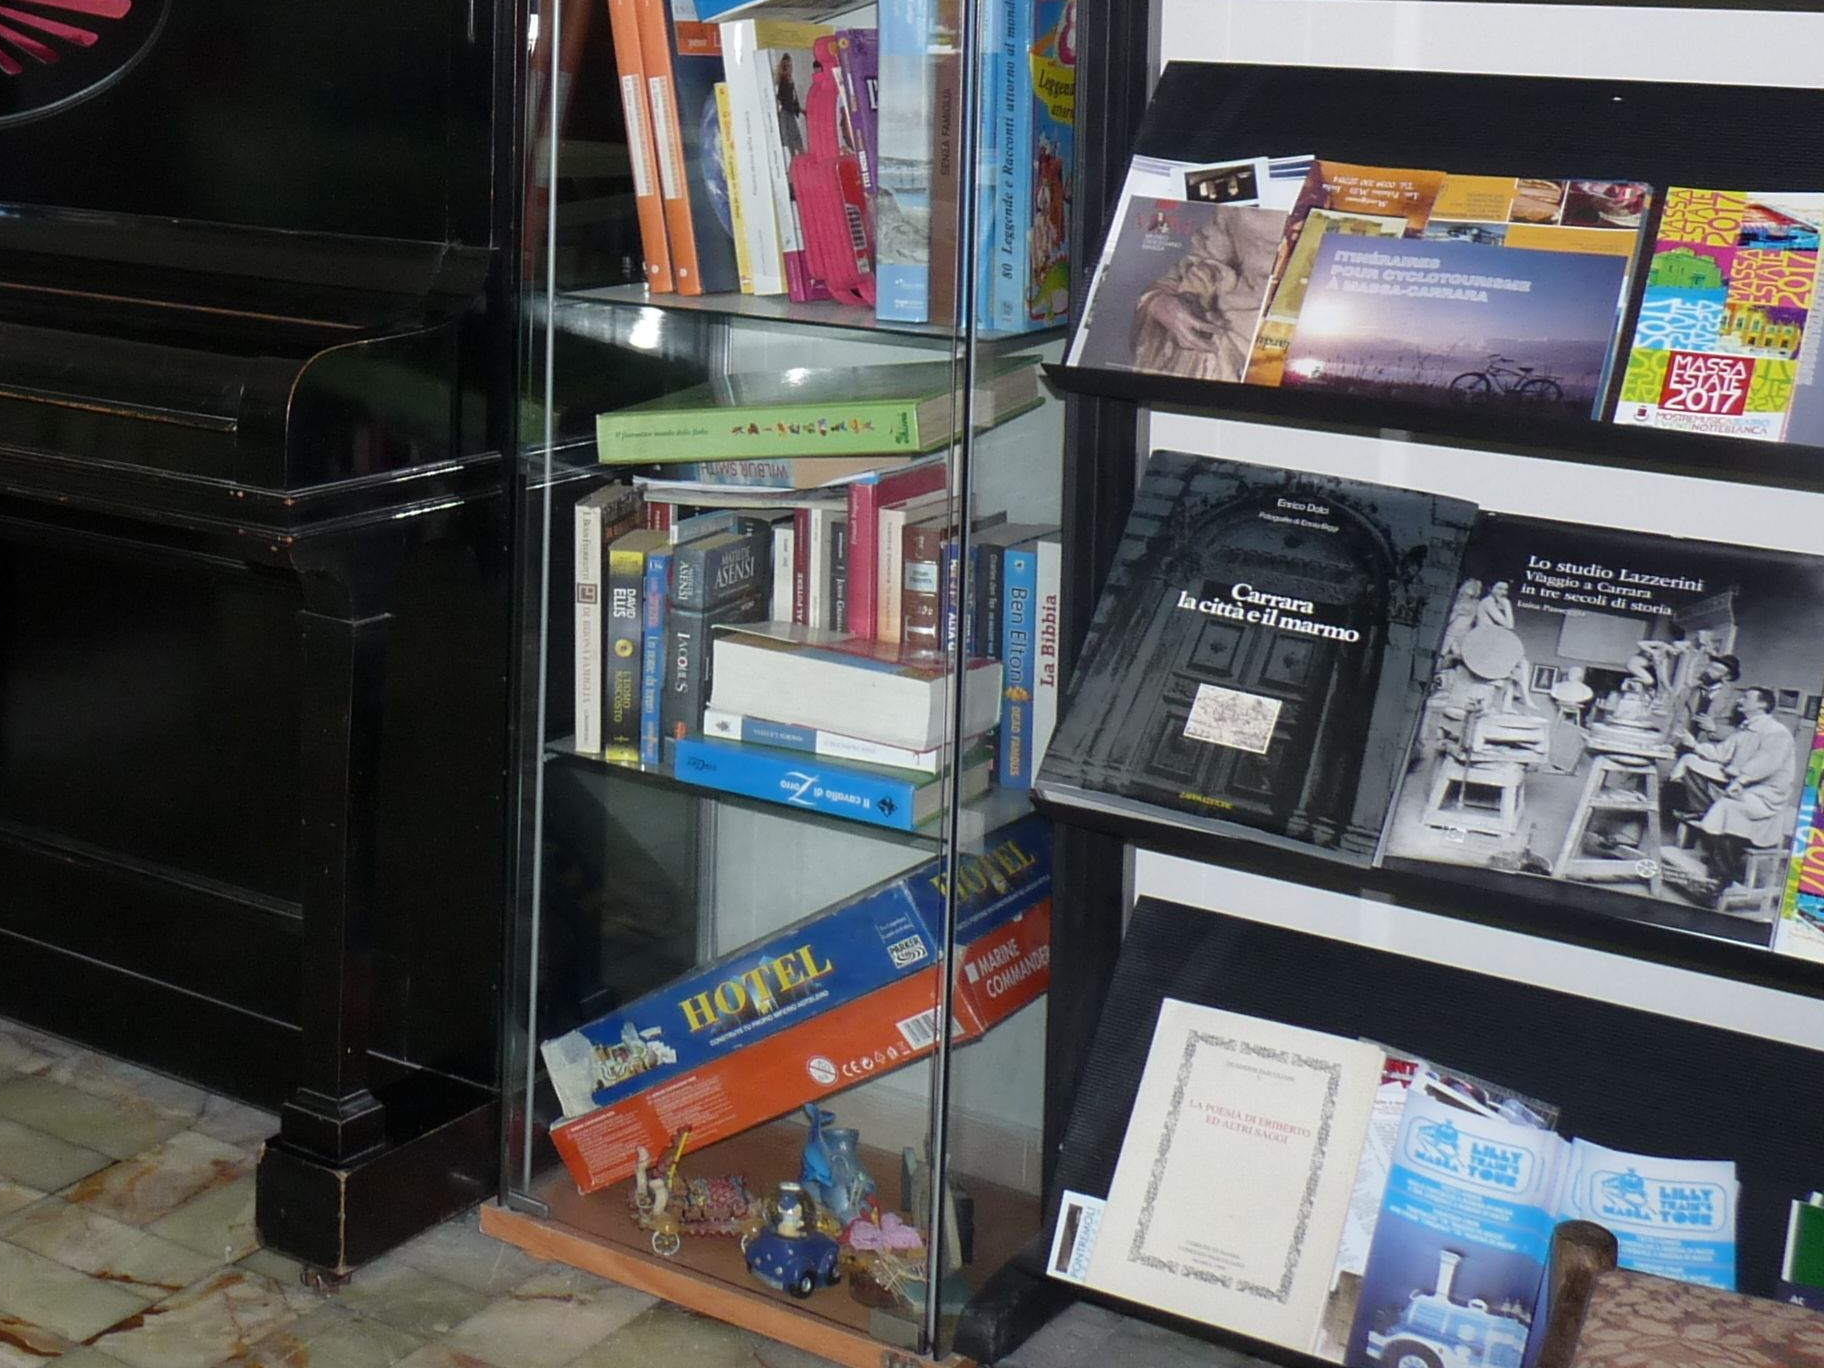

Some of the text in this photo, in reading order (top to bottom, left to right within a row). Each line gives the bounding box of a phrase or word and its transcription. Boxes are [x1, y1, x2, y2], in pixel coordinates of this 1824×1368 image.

[1005, 43, 1016, 57] al
[1006, 59, 1015, 113] attorno
[941, 88, 952, 177] SENZA FAMIGLIA
[1004, 118, 1015, 176] Racconti
[1003, 198, 1016, 257] Leggende
[1659, 189, 1693, 242] MASSA
[1679, 192, 1716, 244] ESTATE
[1704, 192, 1745, 246] 2017
[1005, 260, 1015, 280] 80
[1333, 249, 1441, 269] ITINÉRAIRES
[1330, 265, 1531, 292] POUR CYCLOTOURISME
[1342, 280, 1488, 303] MASSA-CARRARA
[1729, 249, 1761, 303] MASSA
[1750, 249, 1785, 306] ESTATE
[1776, 249, 1820, 309] 2017
[1668, 370, 1743, 395] ESTATE
[1675, 354, 1747, 379] MASSA
[1665, 388, 1743, 413] 2017
[701, 459, 788, 479] WILBUR SMITH
[1277, 498, 1330, 515] Enrico Dolci
[721, 545, 752, 566] MATILDE
[678, 560, 690, 600] ASENSI
[715, 556, 755, 589] ASENSI
[1525, 570, 1653, 599] Viaggio a Carrara
[1528, 555, 1704, 592] Lo studio Lazzerini
[613, 587, 626, 618] ELLIS
[626, 588, 636, 619] DAVID
[1231, 583, 1315, 615] Carrara
[1521, 583, 1673, 616] in tre secoli di storia
[1177, 590, 1360, 643] la città e il marmo
[1009, 587, 1027, 683] Ben Elton
[1041, 594, 1057, 689] La Bibbia
[614, 670, 623, 723] NASCOSTO
[623, 671, 631, 709] L'UOMO
[1010, 706, 1021, 777] DEAD FAMOUS
[780, 770, 819, 807] Zorro
[813, 787, 824, 798] di
[826, 790, 862, 808] cavallo
[889, 936, 921, 954] PARKER
[978, 938, 1021, 977] MARINE
[678, 944, 833, 1033] HOTEL
[1189, 1098, 1312, 1139] LA POESIA DI ERIBERTO
[1205, 1115, 1289, 1145] ED ALTRI SAGGI
[1472, 1143, 1523, 1163] LILLY
[1660, 1185, 1713, 1201] LILLY
